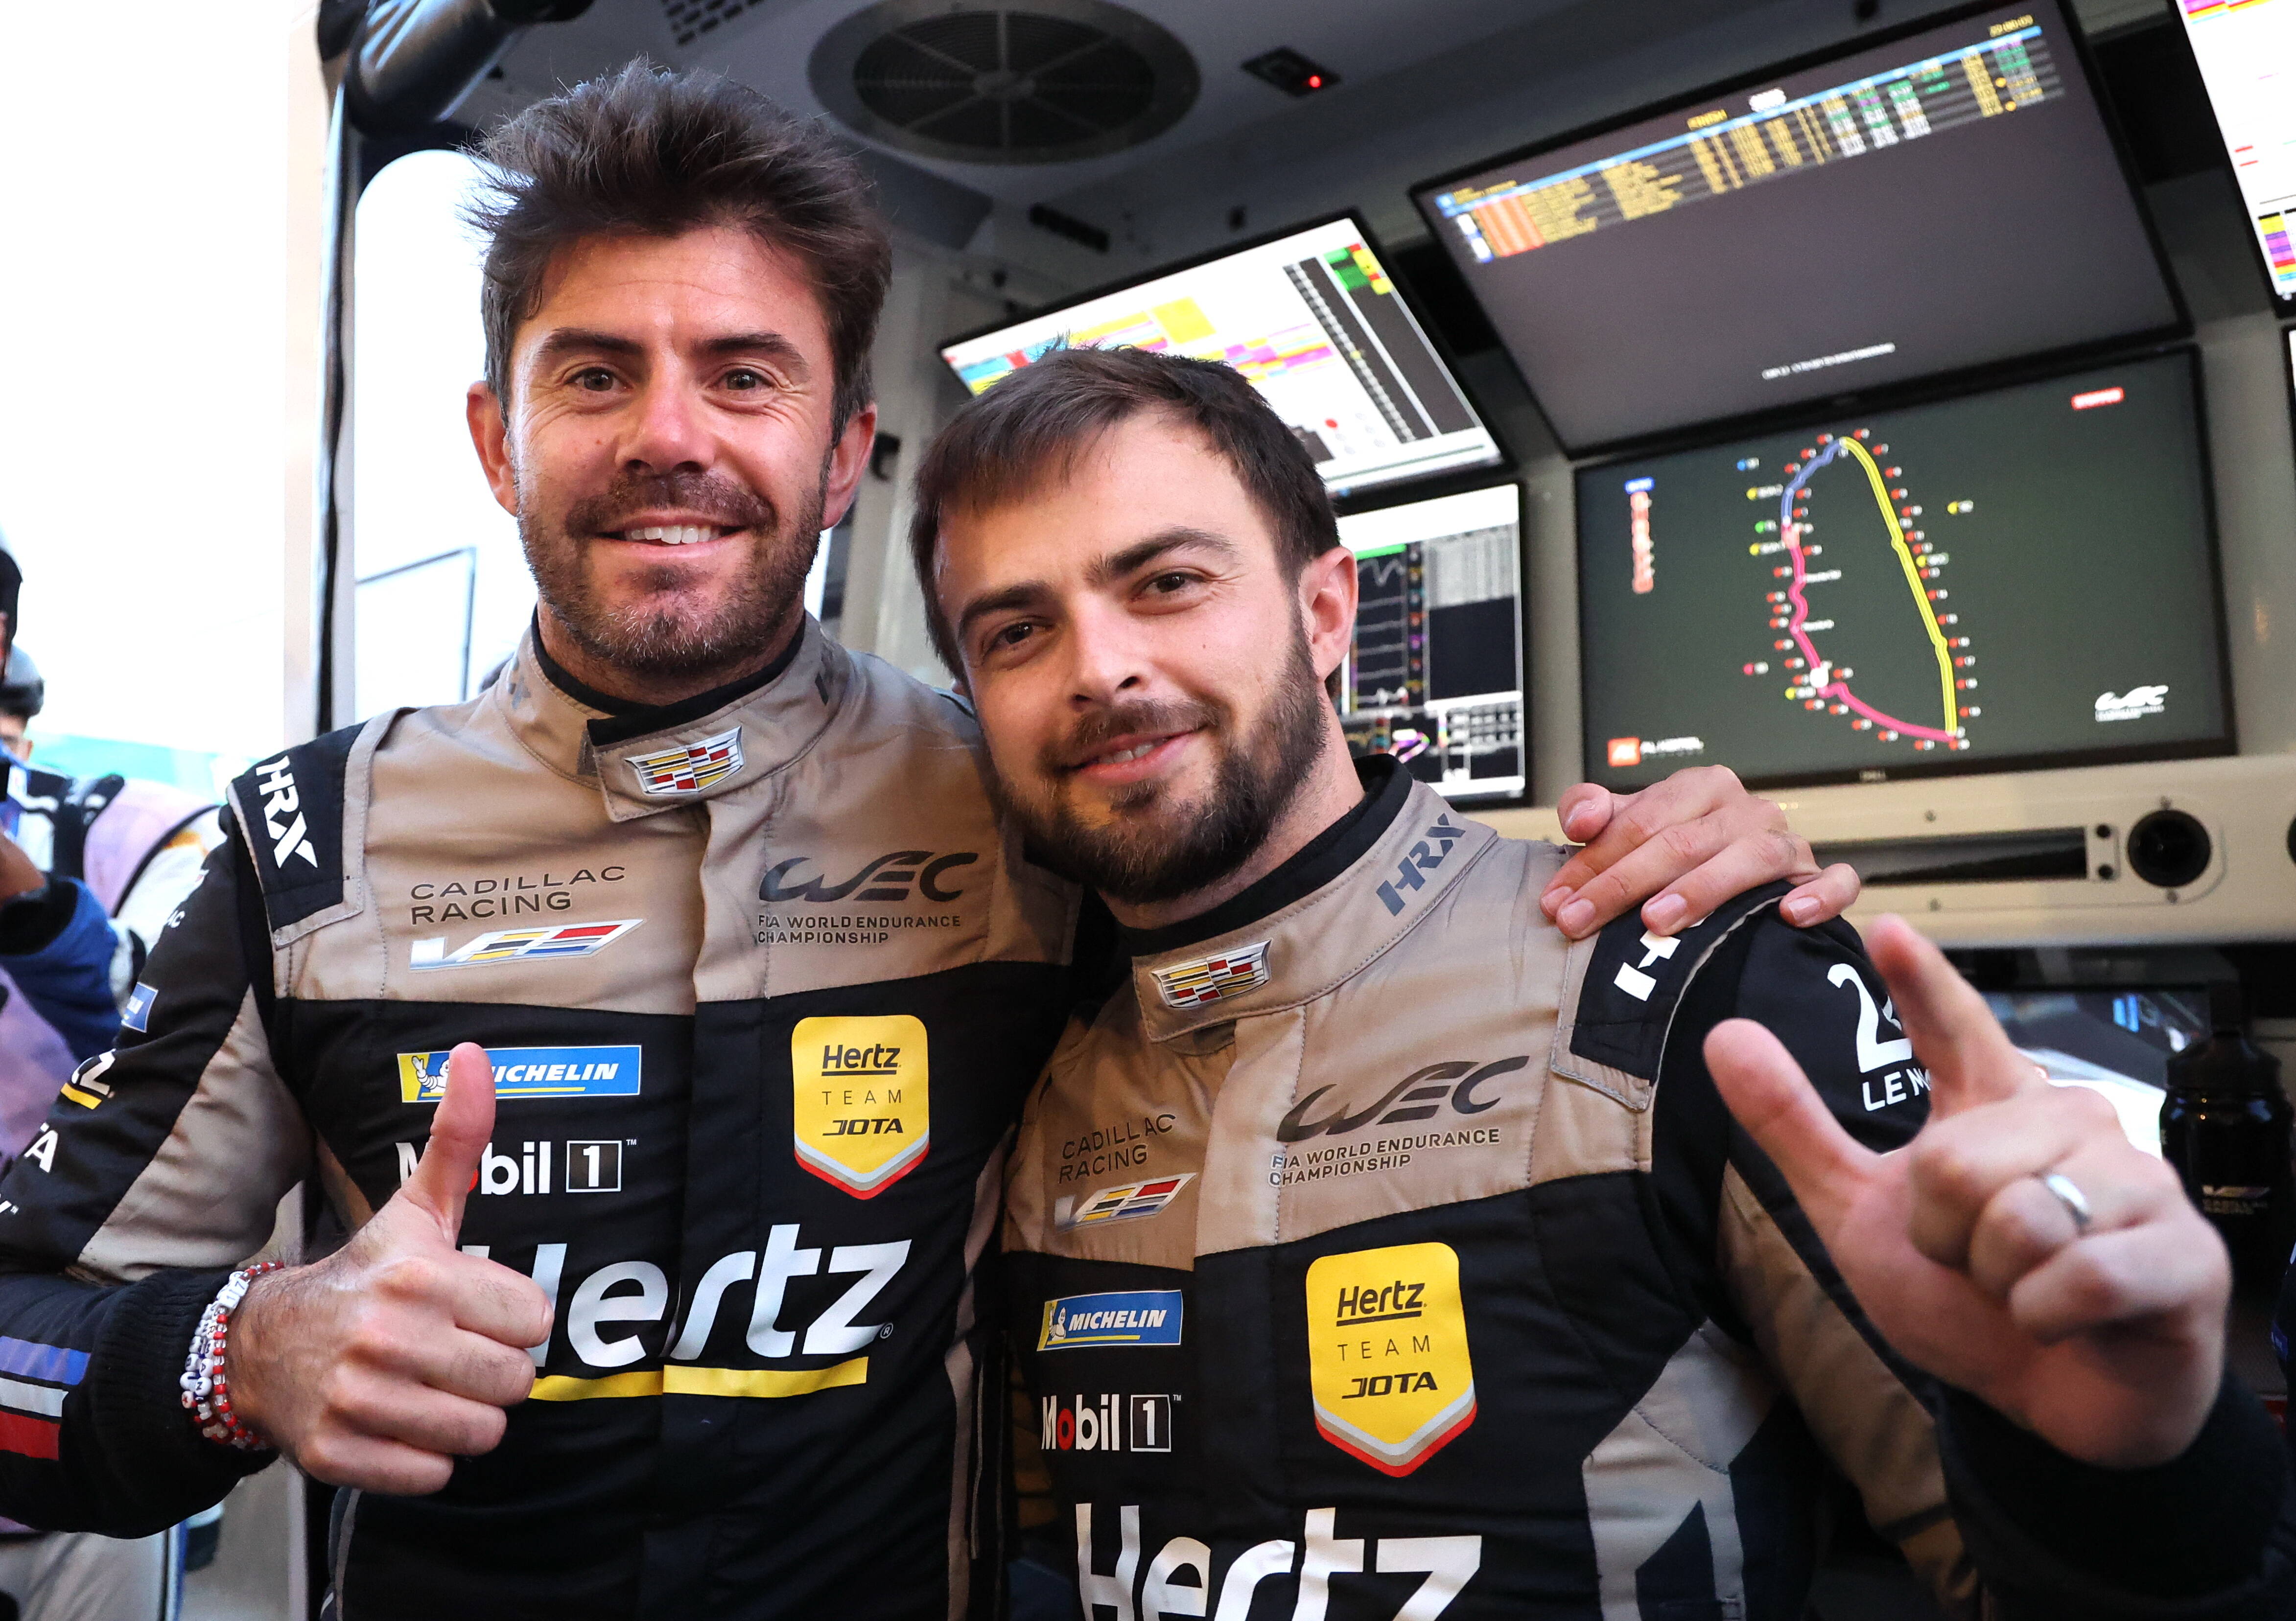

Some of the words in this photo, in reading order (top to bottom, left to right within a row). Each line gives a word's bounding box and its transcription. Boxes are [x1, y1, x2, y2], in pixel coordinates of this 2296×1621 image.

[256, 755, 318, 869] HRX
[759, 850, 978, 903] WEC
[1376, 812, 1466, 917] HRX
[410, 866, 626, 901] CADILLAC
[411, 891, 571, 926] RACING
[758, 914, 780, 928] FIA
[787, 916, 851, 929] WORLD
[856, 915, 961, 928] ENDURANCE
[757, 931, 889, 944] CHAMPIONSHIP
[1827, 963, 1912, 1073] 2
[491, 1063, 619, 1083] ICHELIN
[822, 1043, 901, 1069] Hertz
[821, 1089, 902, 1106] TEAM
[1276, 1055, 1530, 1143] WEC
[822, 1118, 904, 1136] JOTA
[1062, 1113, 1176, 1160] CADILLAC
[1058, 1144, 1148, 1184] RACING
[1271, 1154, 1300, 1170] FIA
[1307, 1142, 1371, 1165] WORLD
[1377, 1128, 1500, 1154] ENDURANCE
[1269, 1154, 1412, 1187] CHAMPIONSHIP
[1336, 1280, 1426, 1319] Hertz
[1068, 1309, 1168, 1332] MICHELIN
[1337, 1334, 1431, 1362] TEAM
[1341, 1371, 1438, 1400] JOTA
[1040, 1393, 1120, 1451] Mobil
[1075, 1503, 1482, 1621] Hertz
